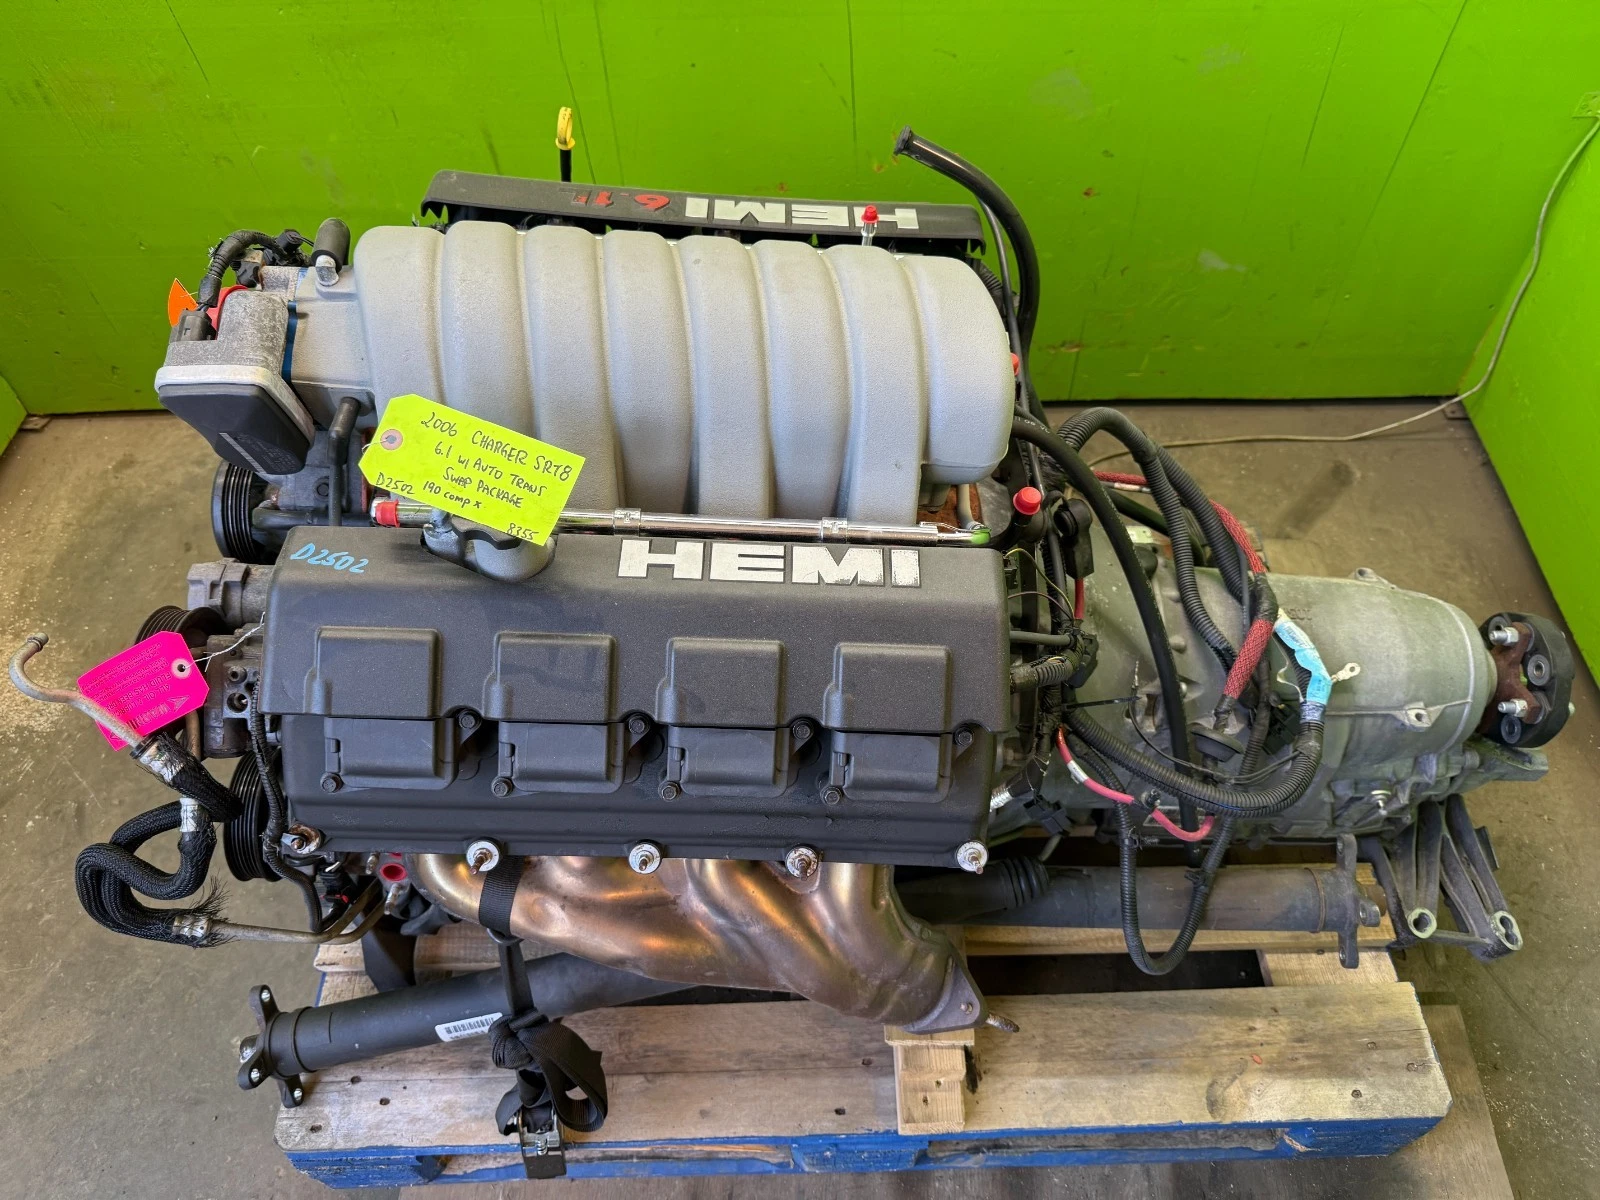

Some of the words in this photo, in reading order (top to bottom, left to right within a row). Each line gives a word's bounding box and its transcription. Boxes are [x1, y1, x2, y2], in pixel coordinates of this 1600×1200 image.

[685, 196, 919, 230] HEMI
[420, 411, 458, 437] 2006
[471, 430, 529, 466] CHARGER
[533, 455, 574, 482] SRT8
[376, 472, 415, 494] D2502
[422, 480, 442, 495] 190
[434, 441, 453, 459] 6.1
[472, 457, 503, 480] AUTO
[509, 473, 547, 497] TRANS
[443, 466, 473, 489] SWAP
[477, 482, 524, 509] PACKAGE
[506, 522, 540, 541] 8355
[290, 542, 369, 574] D2502
[617, 538, 921, 587] HEMI
[133, 683, 149, 697] HAS
[149, 671, 172, 688] FLUID
